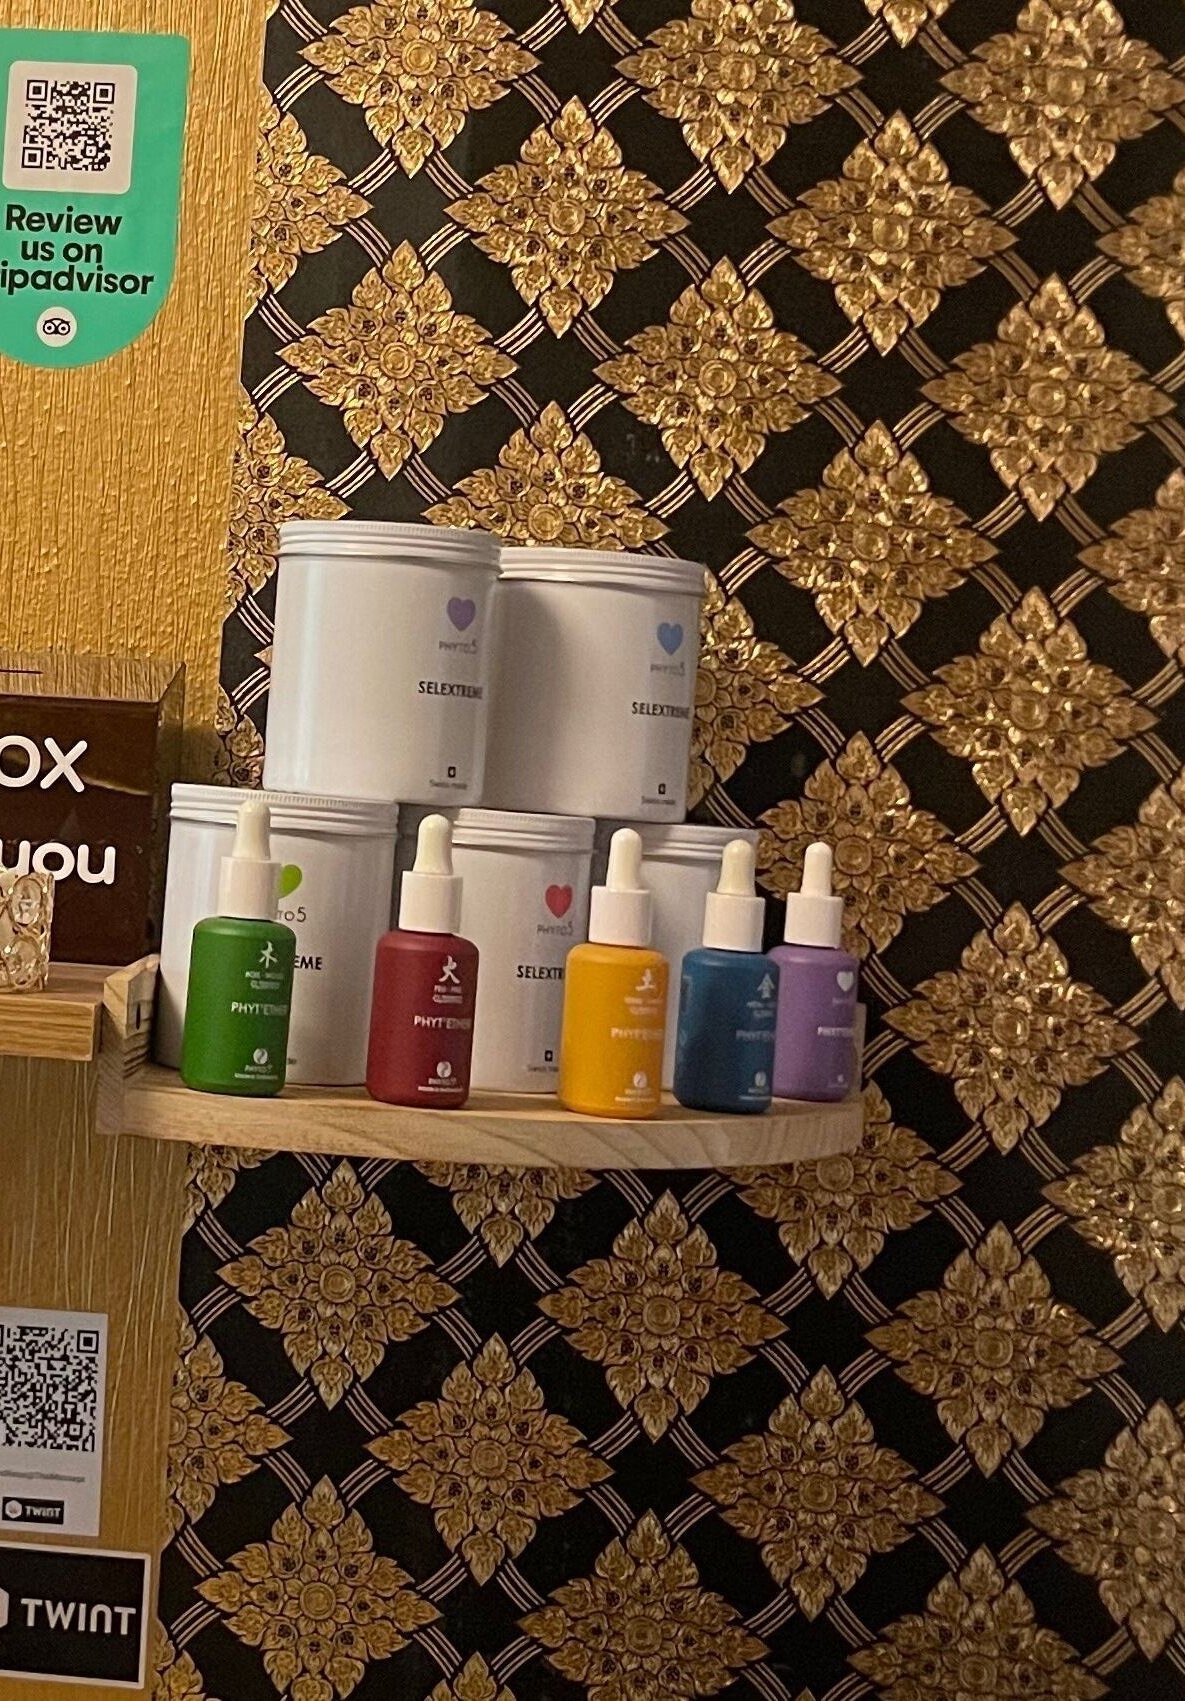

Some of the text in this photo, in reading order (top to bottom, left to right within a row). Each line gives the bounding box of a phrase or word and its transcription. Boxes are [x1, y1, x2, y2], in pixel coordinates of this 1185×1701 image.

[5, 203, 123, 236] Review
[20, 240, 103, 264] us on
[25, 1505, 61, 1518] TWINT
[20, 1597, 137, 1636] TWINT
